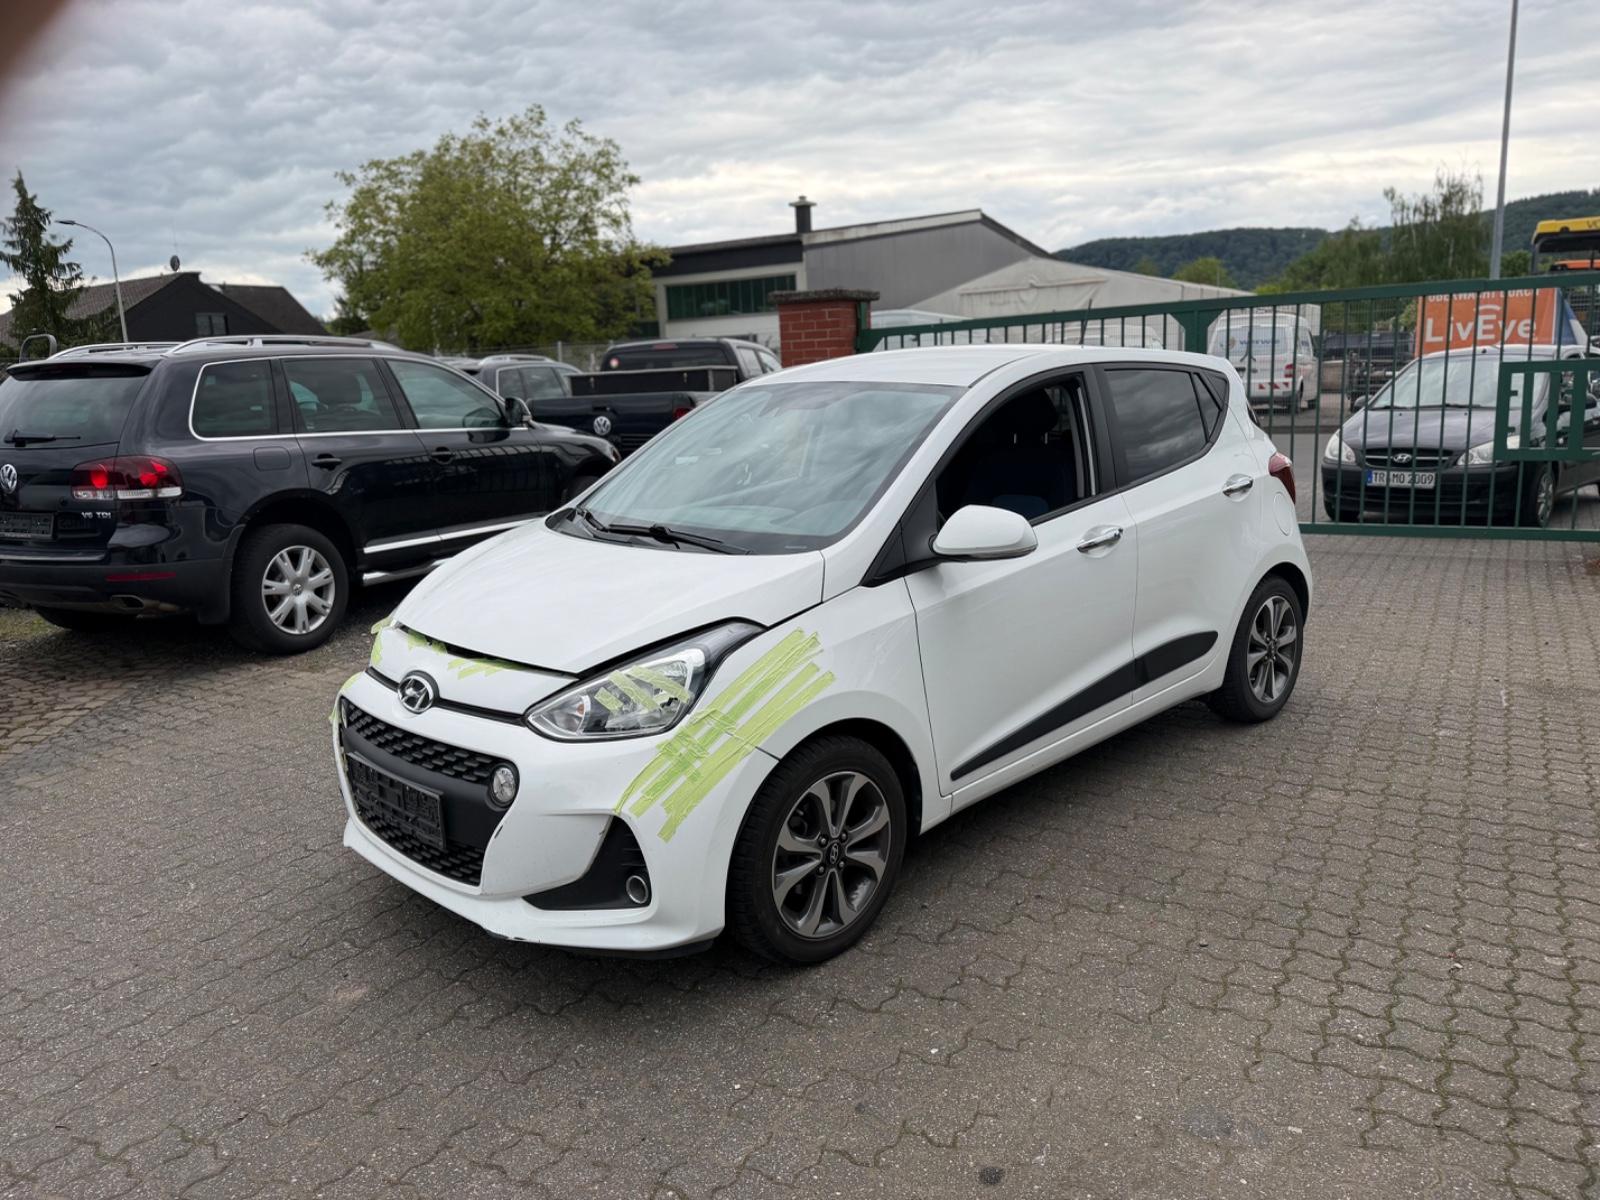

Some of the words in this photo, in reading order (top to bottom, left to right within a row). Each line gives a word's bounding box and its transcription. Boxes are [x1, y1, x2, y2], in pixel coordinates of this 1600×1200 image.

[1425, 314, 1537, 343] LivEye
[1373, 472, 1385, 484] TR
[1408, 474, 1434, 485] 2009
[95, 511, 111, 519] TDI
